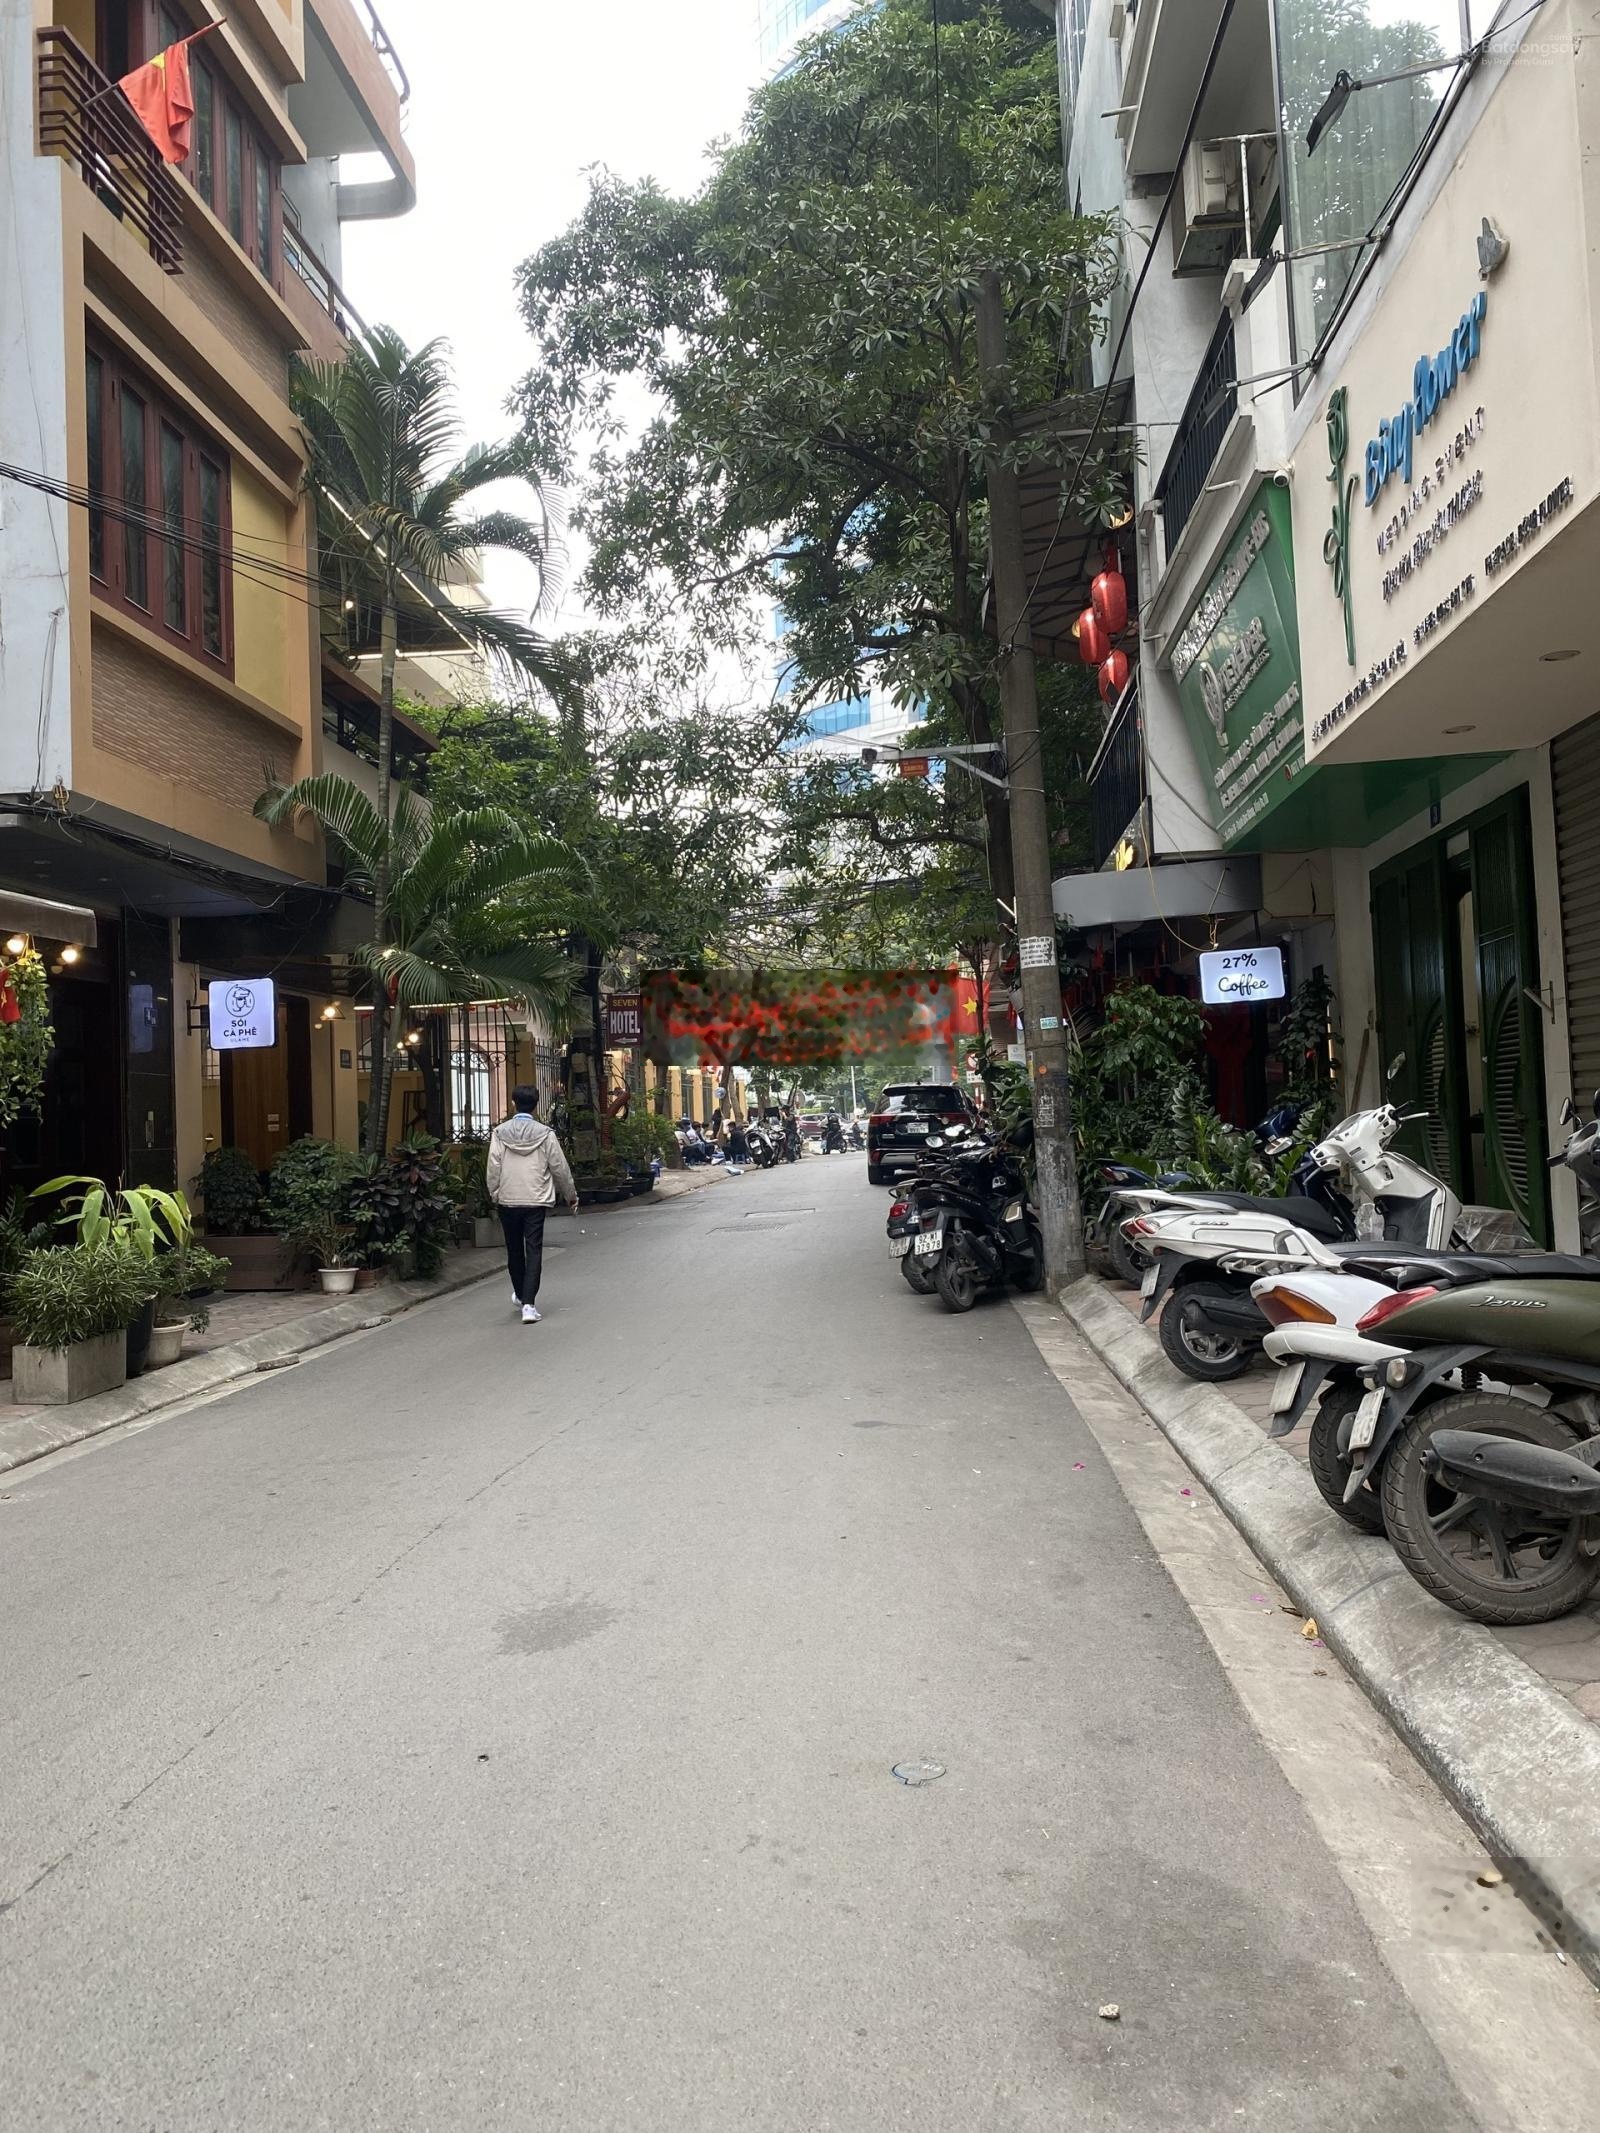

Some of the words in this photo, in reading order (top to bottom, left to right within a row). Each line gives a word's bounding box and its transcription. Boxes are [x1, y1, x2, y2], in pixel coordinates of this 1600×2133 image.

[1222, 953, 1257, 969] 27%
[1218, 973, 1269, 996] Coffee
[612, 999, 638, 1007] SEVEN
[610, 1010, 641, 1034] HOTEL
[223, 1028, 236, 1037] CÀ
[238, 1026, 257, 1036] PHÊ
[1468, 1294, 1548, 1308] Janus
